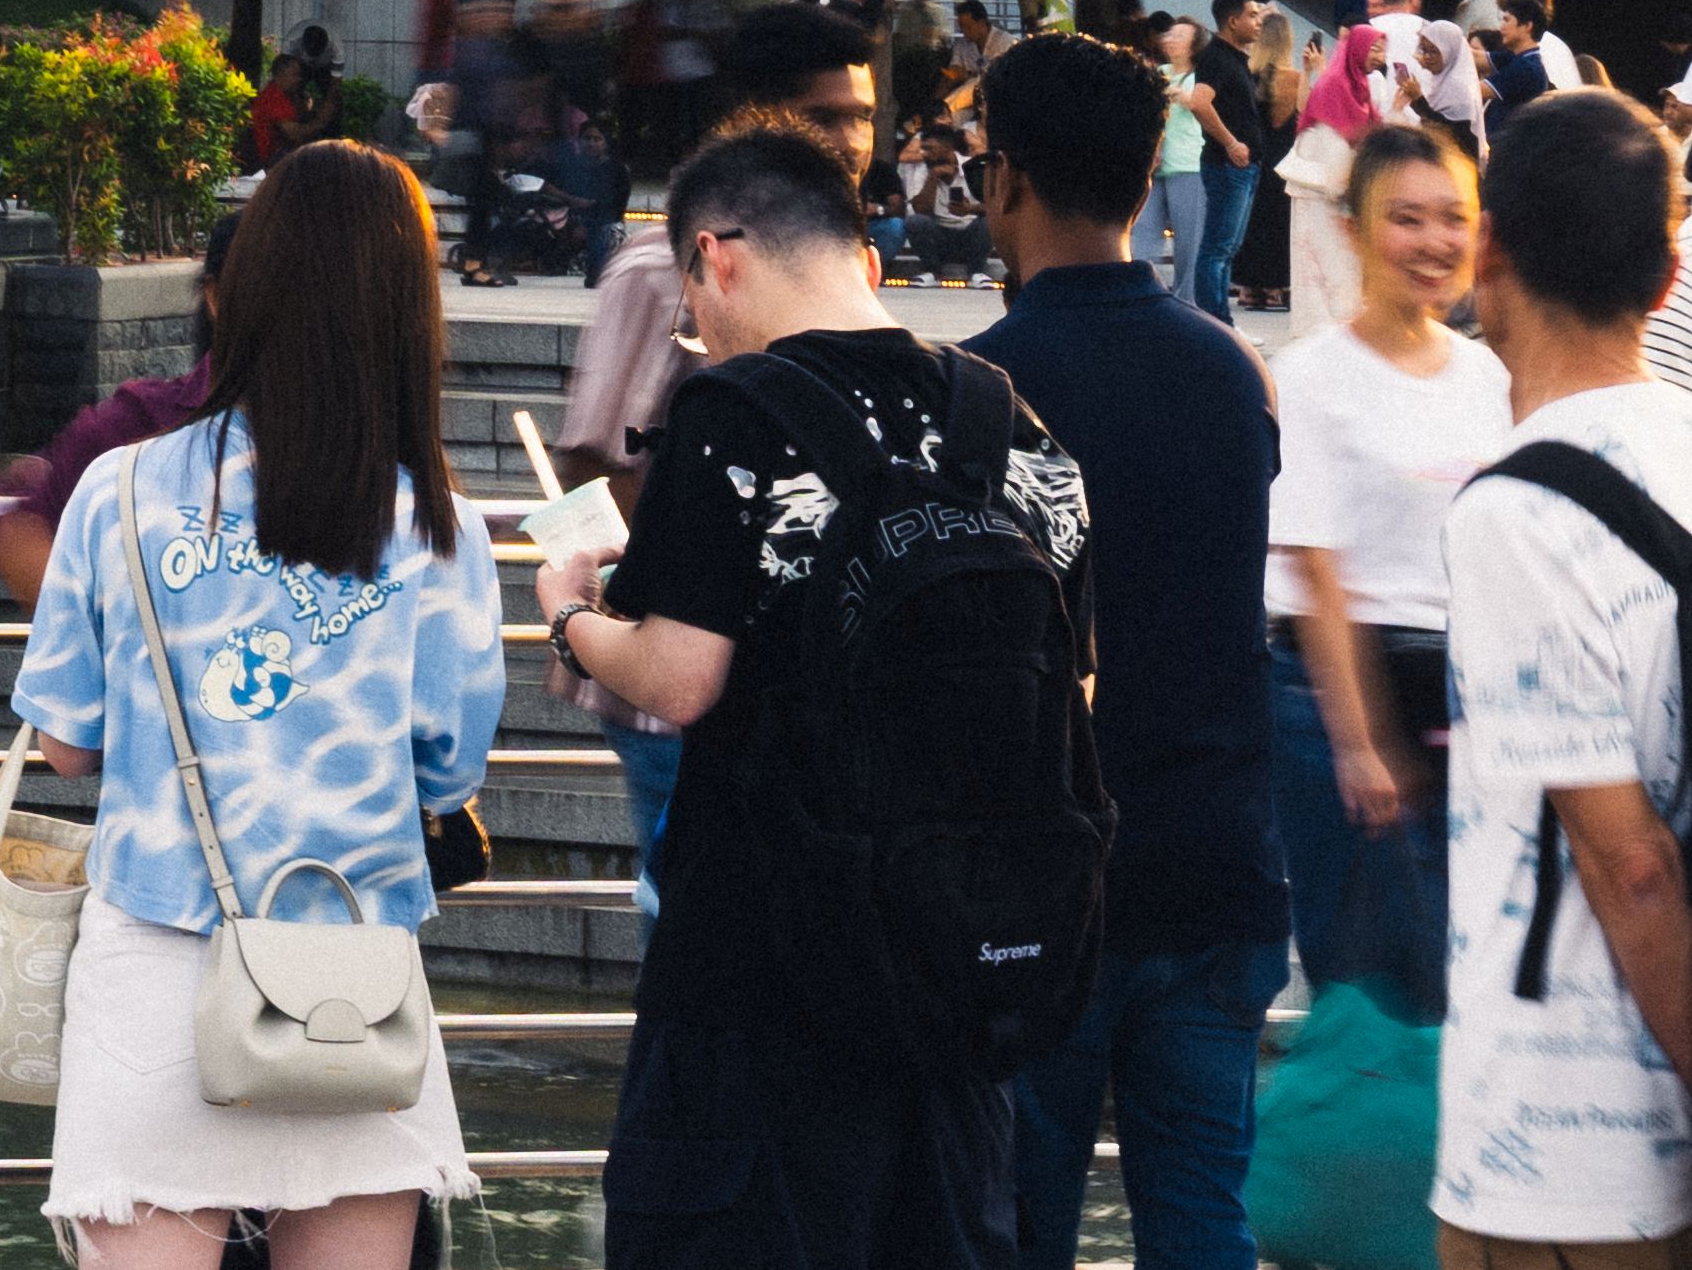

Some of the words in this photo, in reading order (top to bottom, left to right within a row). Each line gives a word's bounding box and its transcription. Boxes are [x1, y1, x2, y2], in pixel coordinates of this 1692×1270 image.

[159, 532, 224, 593] ON
[279, 563, 321, 621] way
[977, 941, 1042, 967] Supreme
